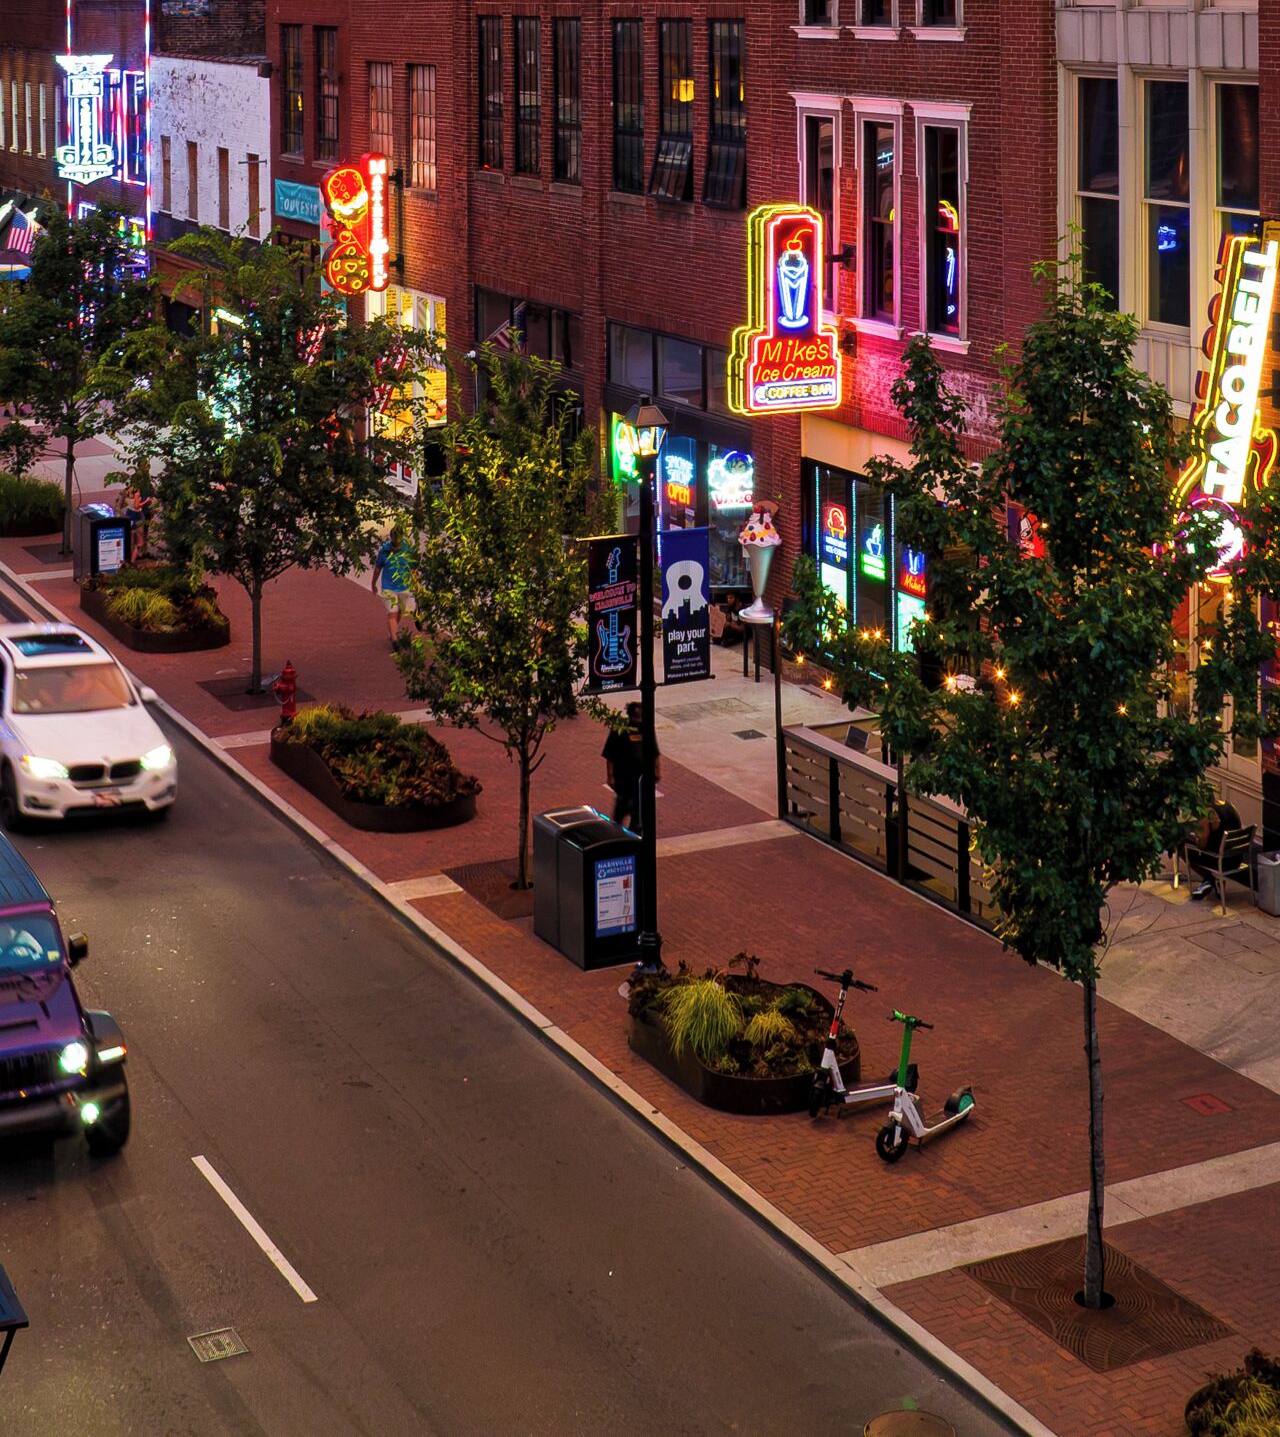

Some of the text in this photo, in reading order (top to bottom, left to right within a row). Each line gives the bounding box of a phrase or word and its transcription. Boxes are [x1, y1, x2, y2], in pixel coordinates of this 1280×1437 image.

[1228, 240, 1279, 359] BELL
[762, 338, 830, 363] Mike's
[755, 363, 836, 382] Ice Cream
[767, 383, 833, 400] COFFEE BAR
[1203, 362, 1260, 505] TACO
[667, 482, 691, 505] OPEN
[594, 593, 634, 610] NASHVILLE
[668, 627, 706, 642] play your
[677, 642, 698, 655] part.
[597, 858, 633, 869] NASHVILLE
